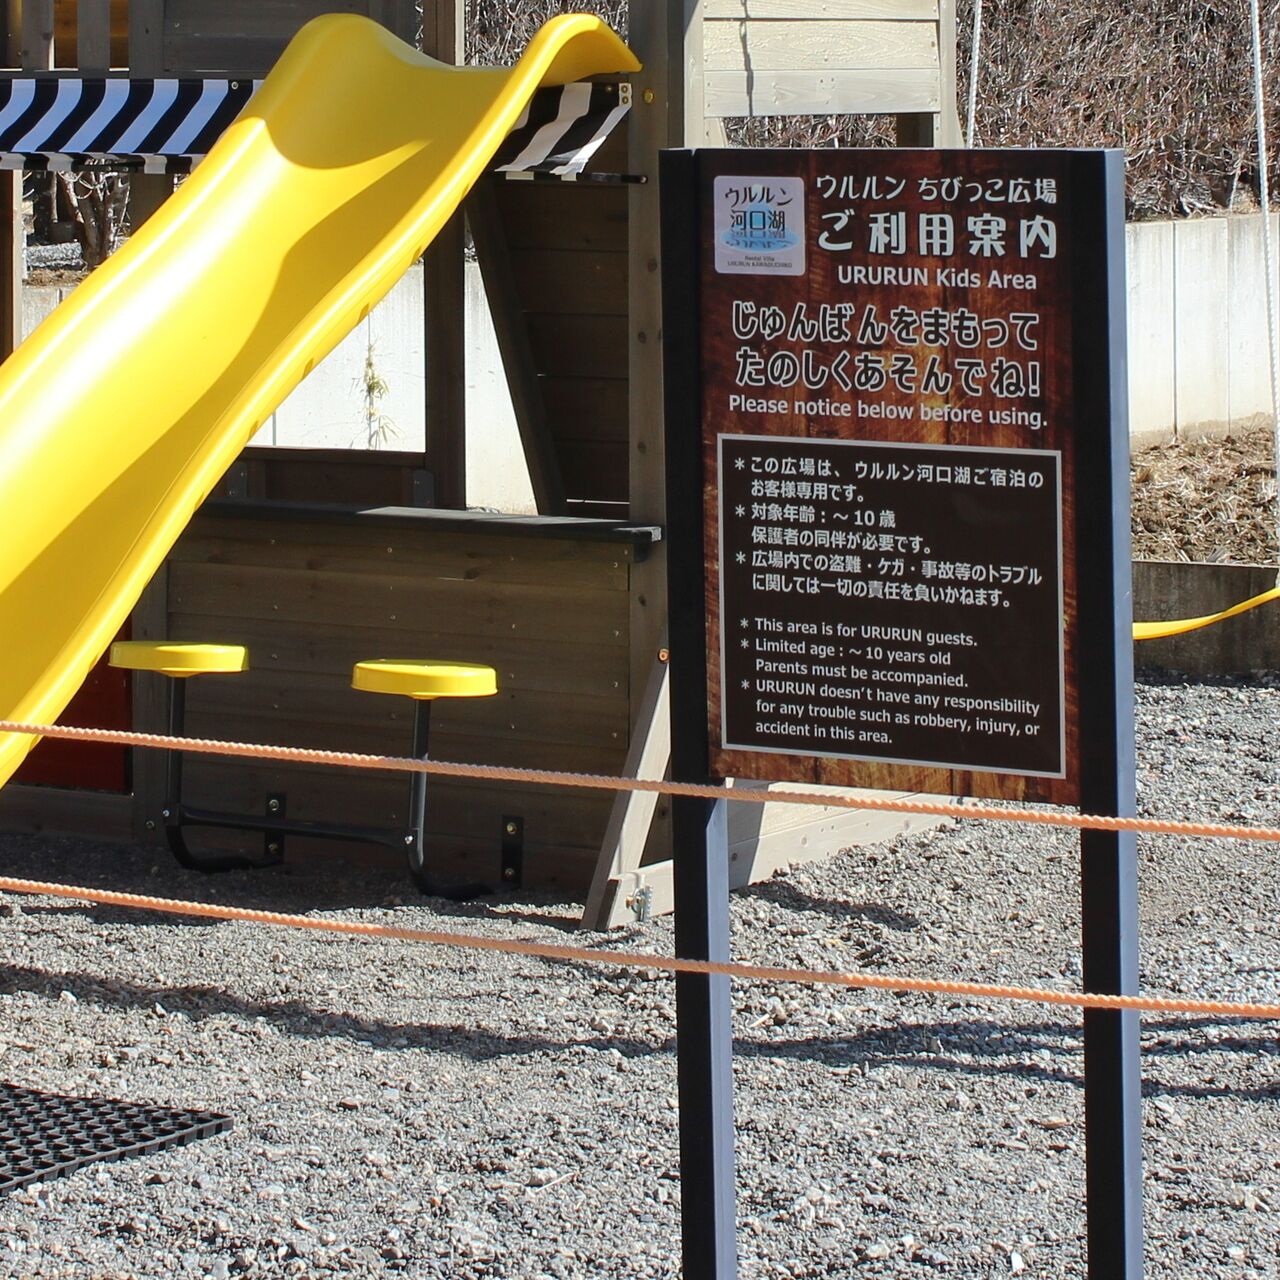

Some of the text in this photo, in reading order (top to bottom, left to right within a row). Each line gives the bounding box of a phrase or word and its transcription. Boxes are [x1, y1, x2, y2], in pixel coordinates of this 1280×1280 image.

[725, 186, 794, 208] ウルルン
[816, 175, 1057, 204] ウルルン ちびっこ広場
[730, 209, 786, 231] 河口湖
[818, 208, 1057, 259] ご利用案内
[838, 265, 1037, 290] URURUN Kids Area
[732, 300, 1039, 350] じゅんばんをまもって
[729, 394, 1048, 430] Please notice below before using.
[751, 479, 864, 502] お客様専用です。
[751, 525, 931, 554] 保護者の同伴が必要です。
[755, 618, 977, 646] This area is for URURUN guests.
[755, 638, 806, 654] Limited
[810, 644, 835, 658] age
[865, 646, 883, 660] 10
[887, 650, 926, 663] years
[929, 651, 951, 665] old
[756, 658, 968, 687] Parents must be accompanied.
[756, 679, 815, 696] URURUN
[877, 688, 910, 703] have
[914, 694, 940, 709] any
[944, 696, 1040, 717] responsibility
[756, 699, 1040, 736] for any trouble such as robbery, injury, or
[756, 721, 893, 744] accident in this area.
